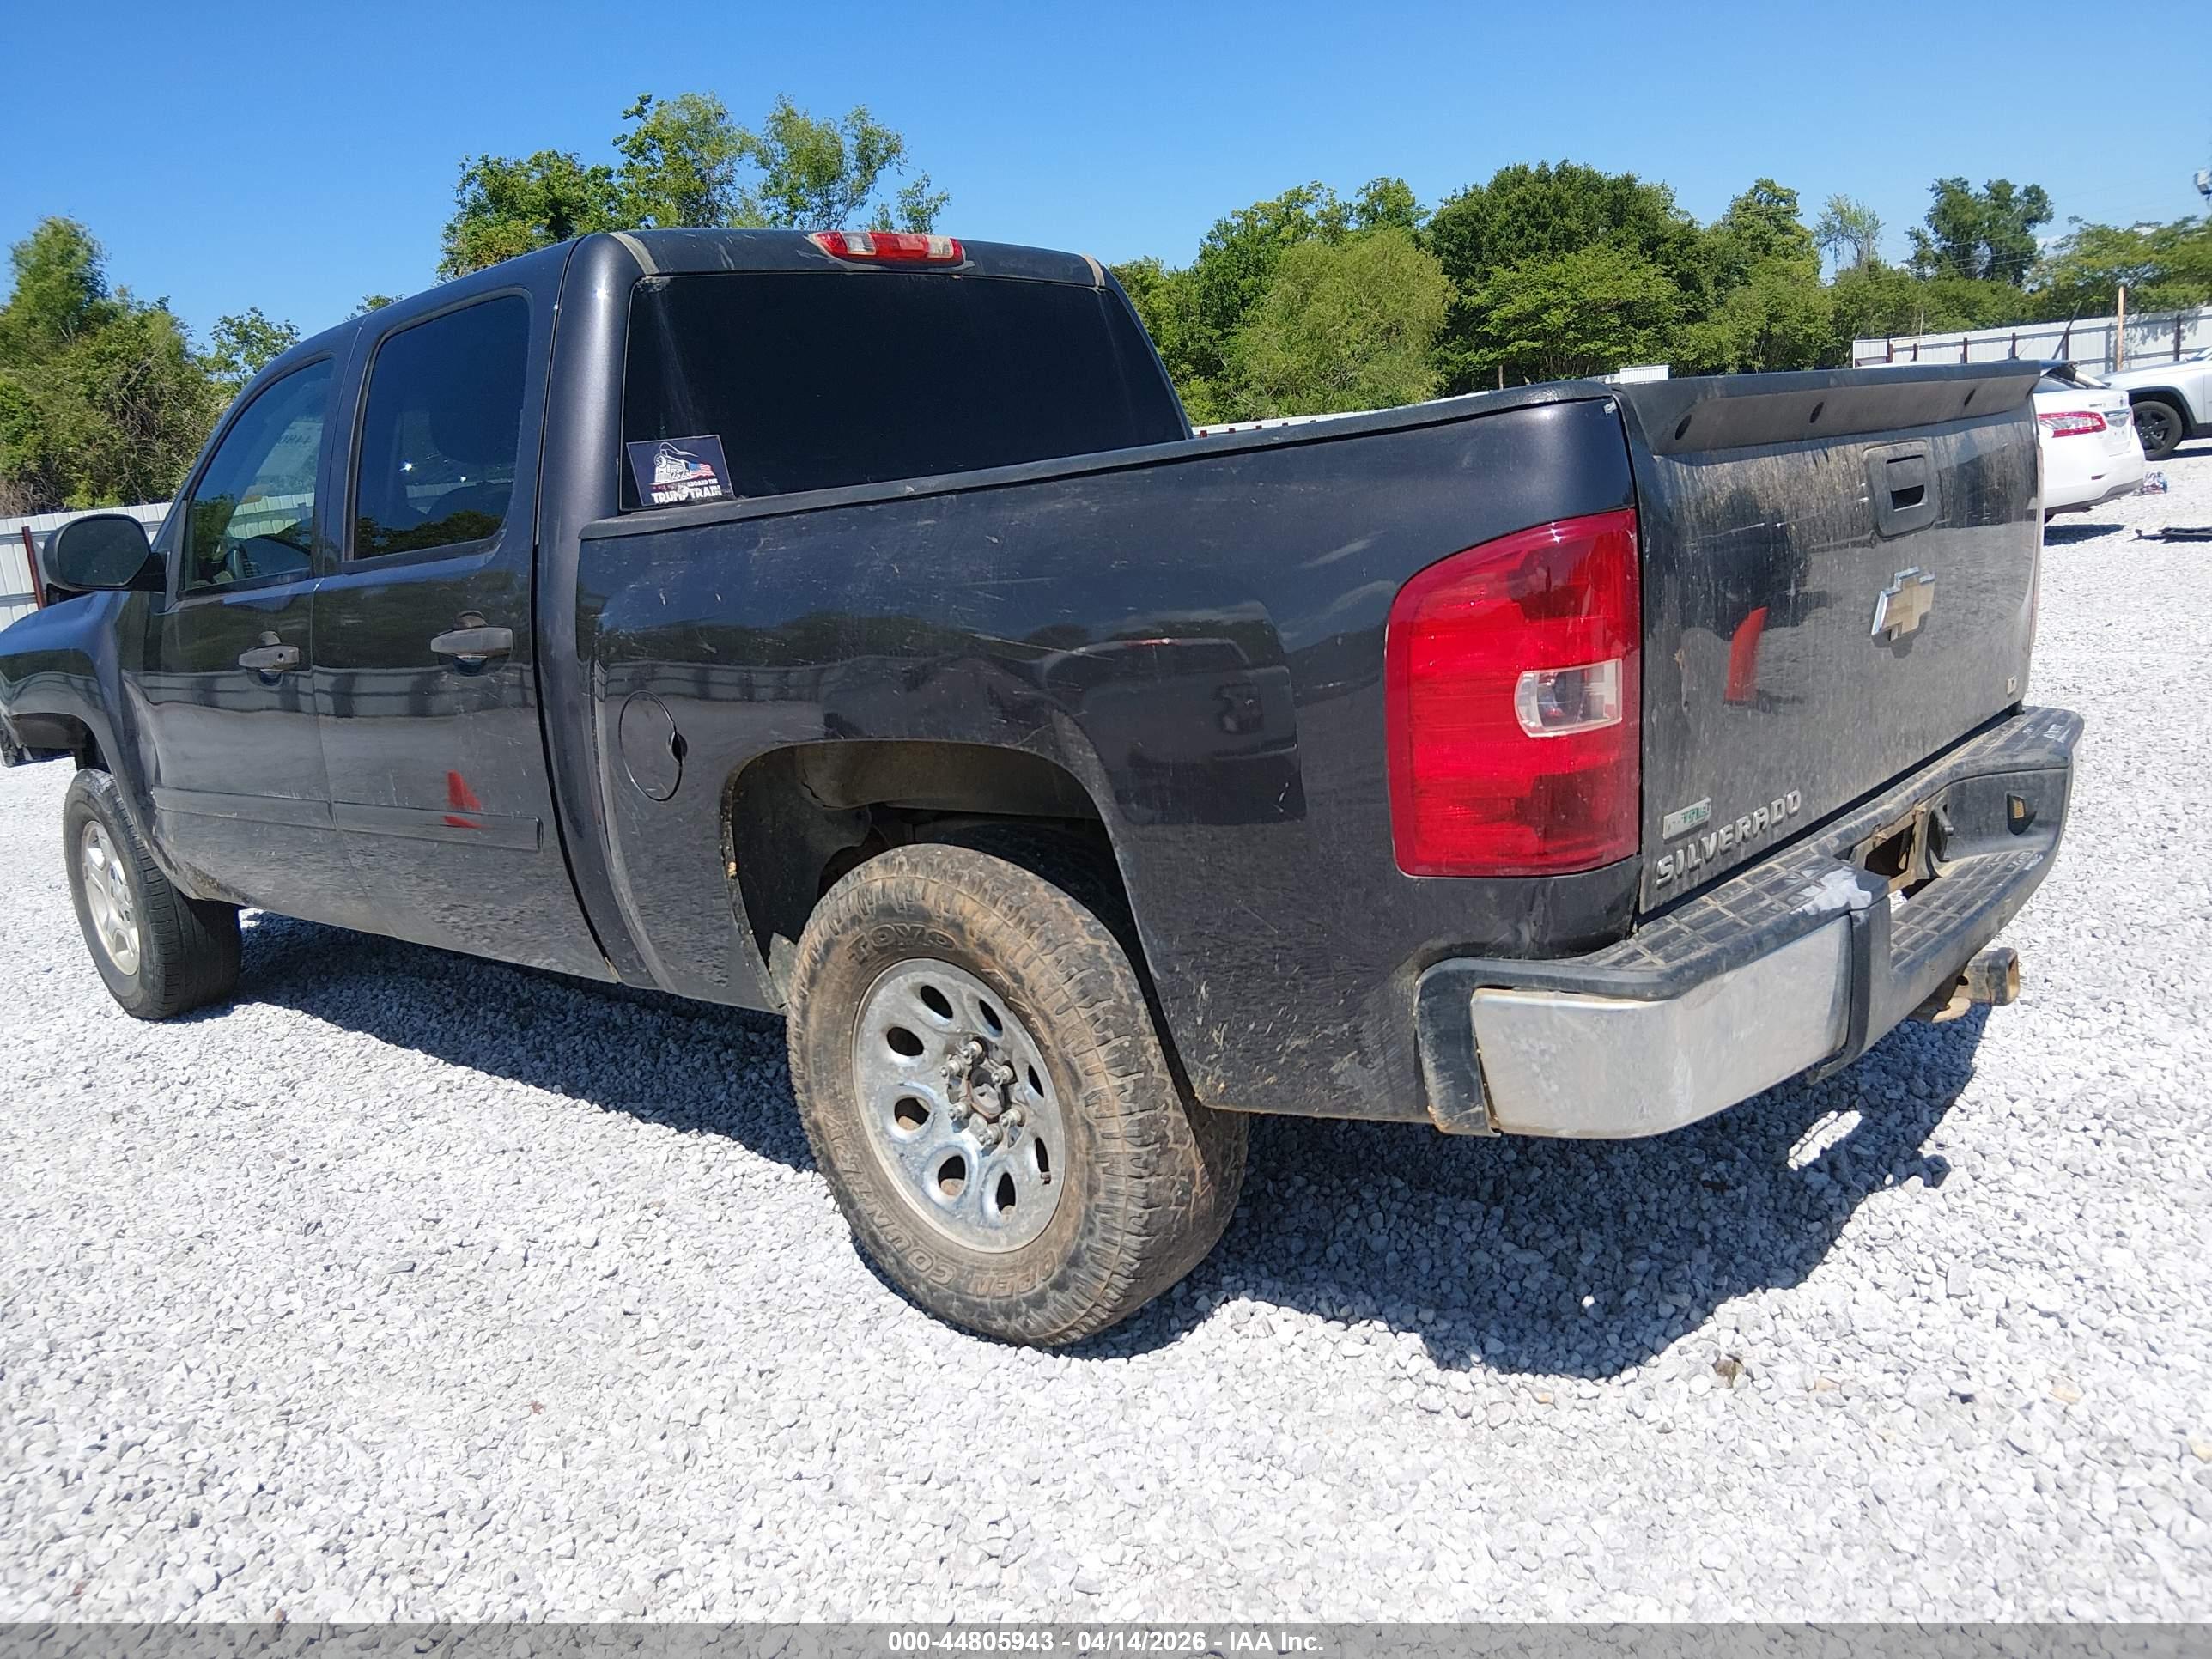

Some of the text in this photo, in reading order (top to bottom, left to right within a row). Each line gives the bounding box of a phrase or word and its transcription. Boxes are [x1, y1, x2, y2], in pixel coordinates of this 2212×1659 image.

[651, 491, 689, 504] TRUMP
[688, 485, 722, 499] TRAIN
[1656, 789, 1802, 885] SILVERADO
[847, 921, 956, 961] TOYO
